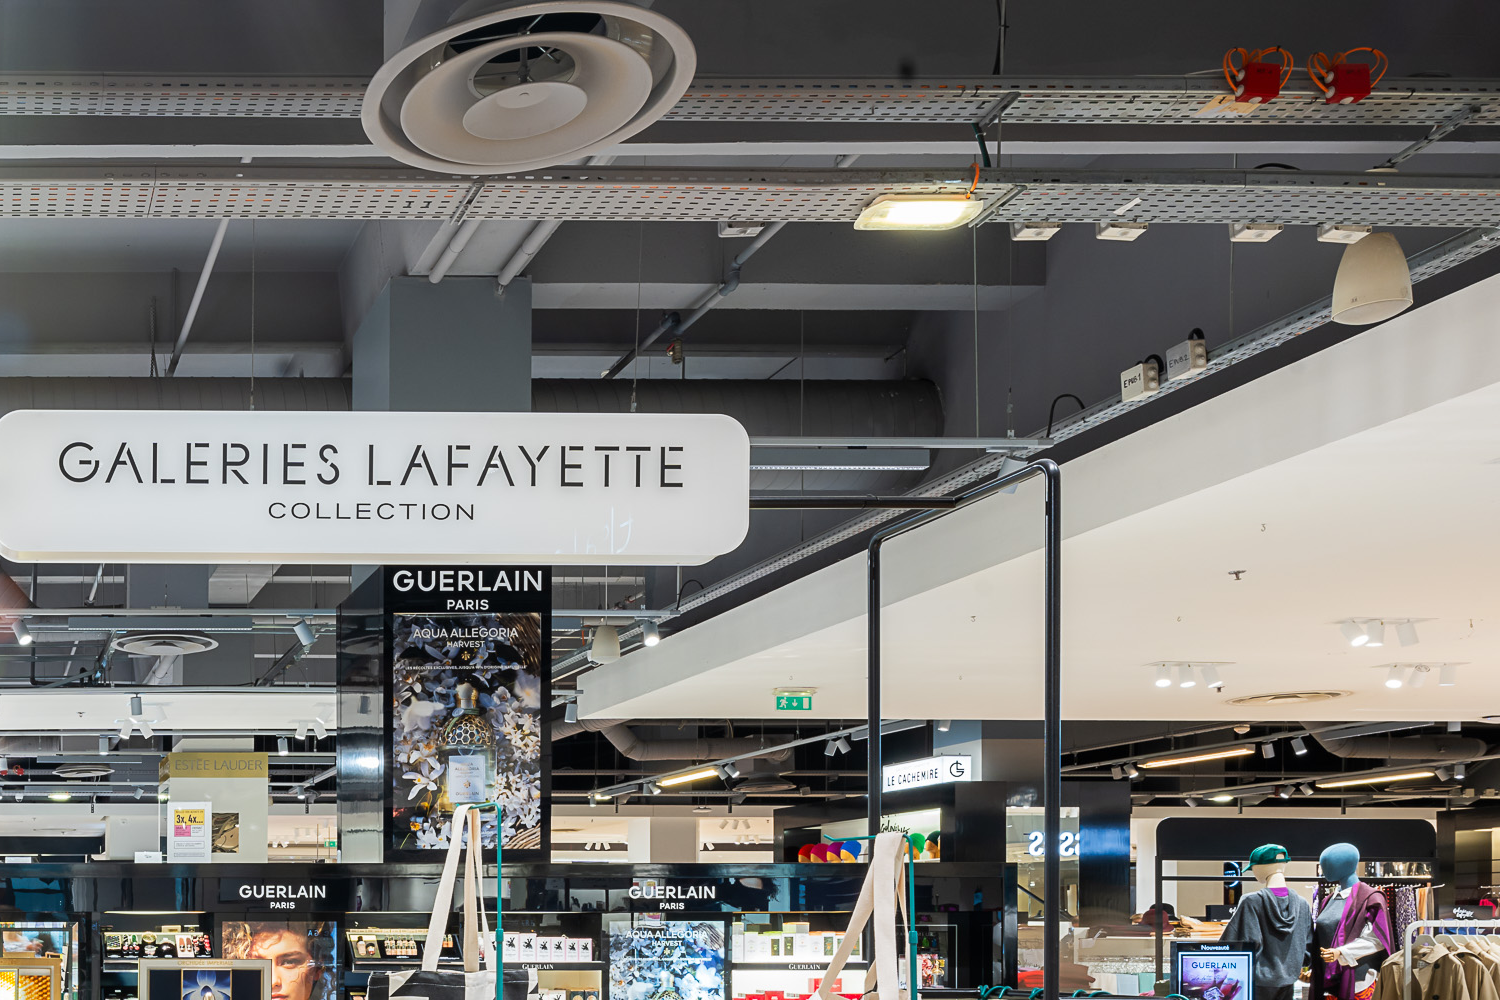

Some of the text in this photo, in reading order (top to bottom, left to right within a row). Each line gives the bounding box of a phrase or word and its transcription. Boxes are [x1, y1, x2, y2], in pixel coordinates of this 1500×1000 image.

[59, 441, 685, 488] GALERIES LAFAYETTE
[268, 502, 475, 521] COLLECTION
[392, 570, 543, 592] GUERLAIN
[446, 599, 489, 610] PARIS
[413, 627, 519, 638] AQUA ALLEGORIA
[214, 759, 263, 770] LAUDER
[887, 768, 938, 787] LE CACHEMIRE
[239, 885, 326, 899] GUERLAIN
[628, 885, 716, 900] GUERLAIN
[659, 902, 685, 910] PARIS
[625, 930, 709, 939] AQUA ALLEGORIA
[1191, 961, 1237, 969] GUERLAIN
